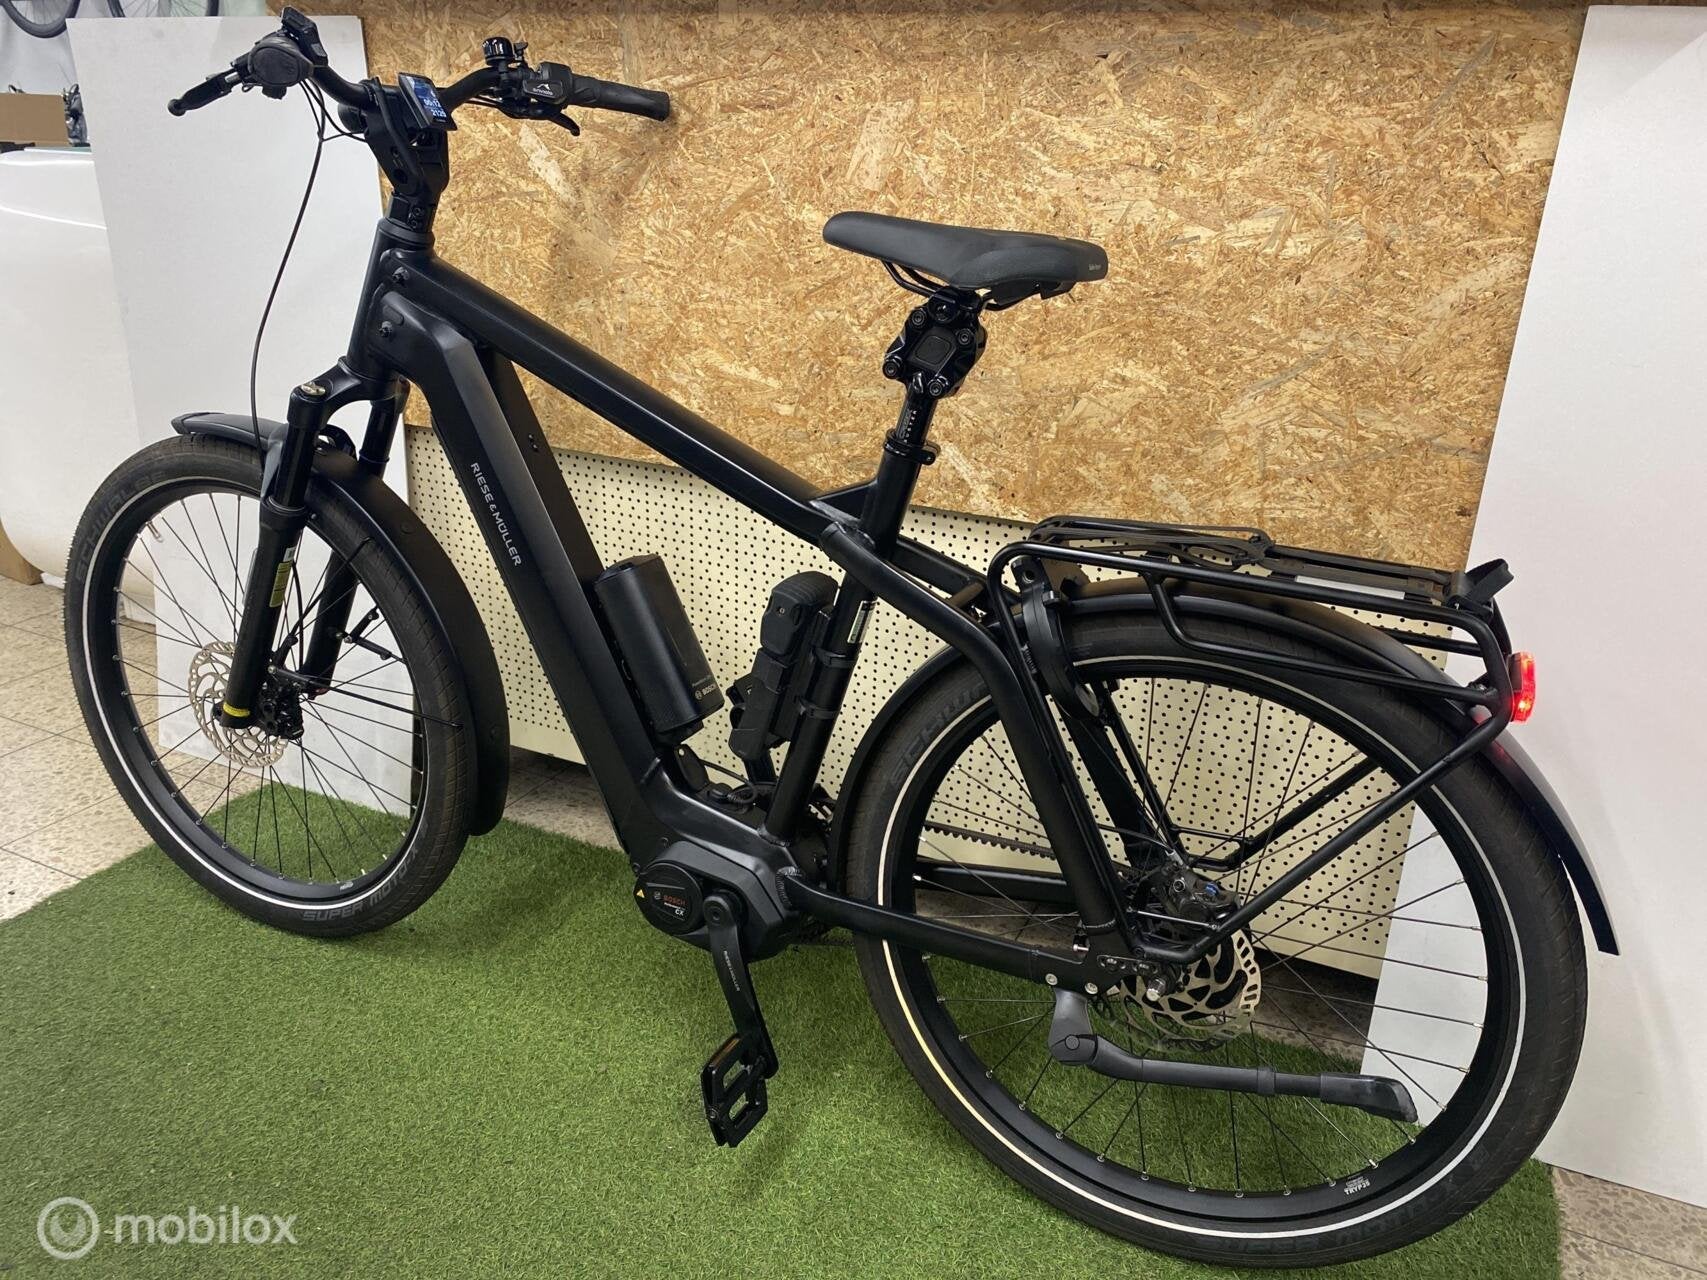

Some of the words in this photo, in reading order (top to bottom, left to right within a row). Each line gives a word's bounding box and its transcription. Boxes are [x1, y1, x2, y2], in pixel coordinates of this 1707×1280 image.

[470, 462, 494, 504] RIESE
[491, 511, 522, 566] MÜLLER
[663, 894, 686, 906] BOSCH
[302, 900, 363, 922] SUPER
[674, 908, 685, 917] CX
